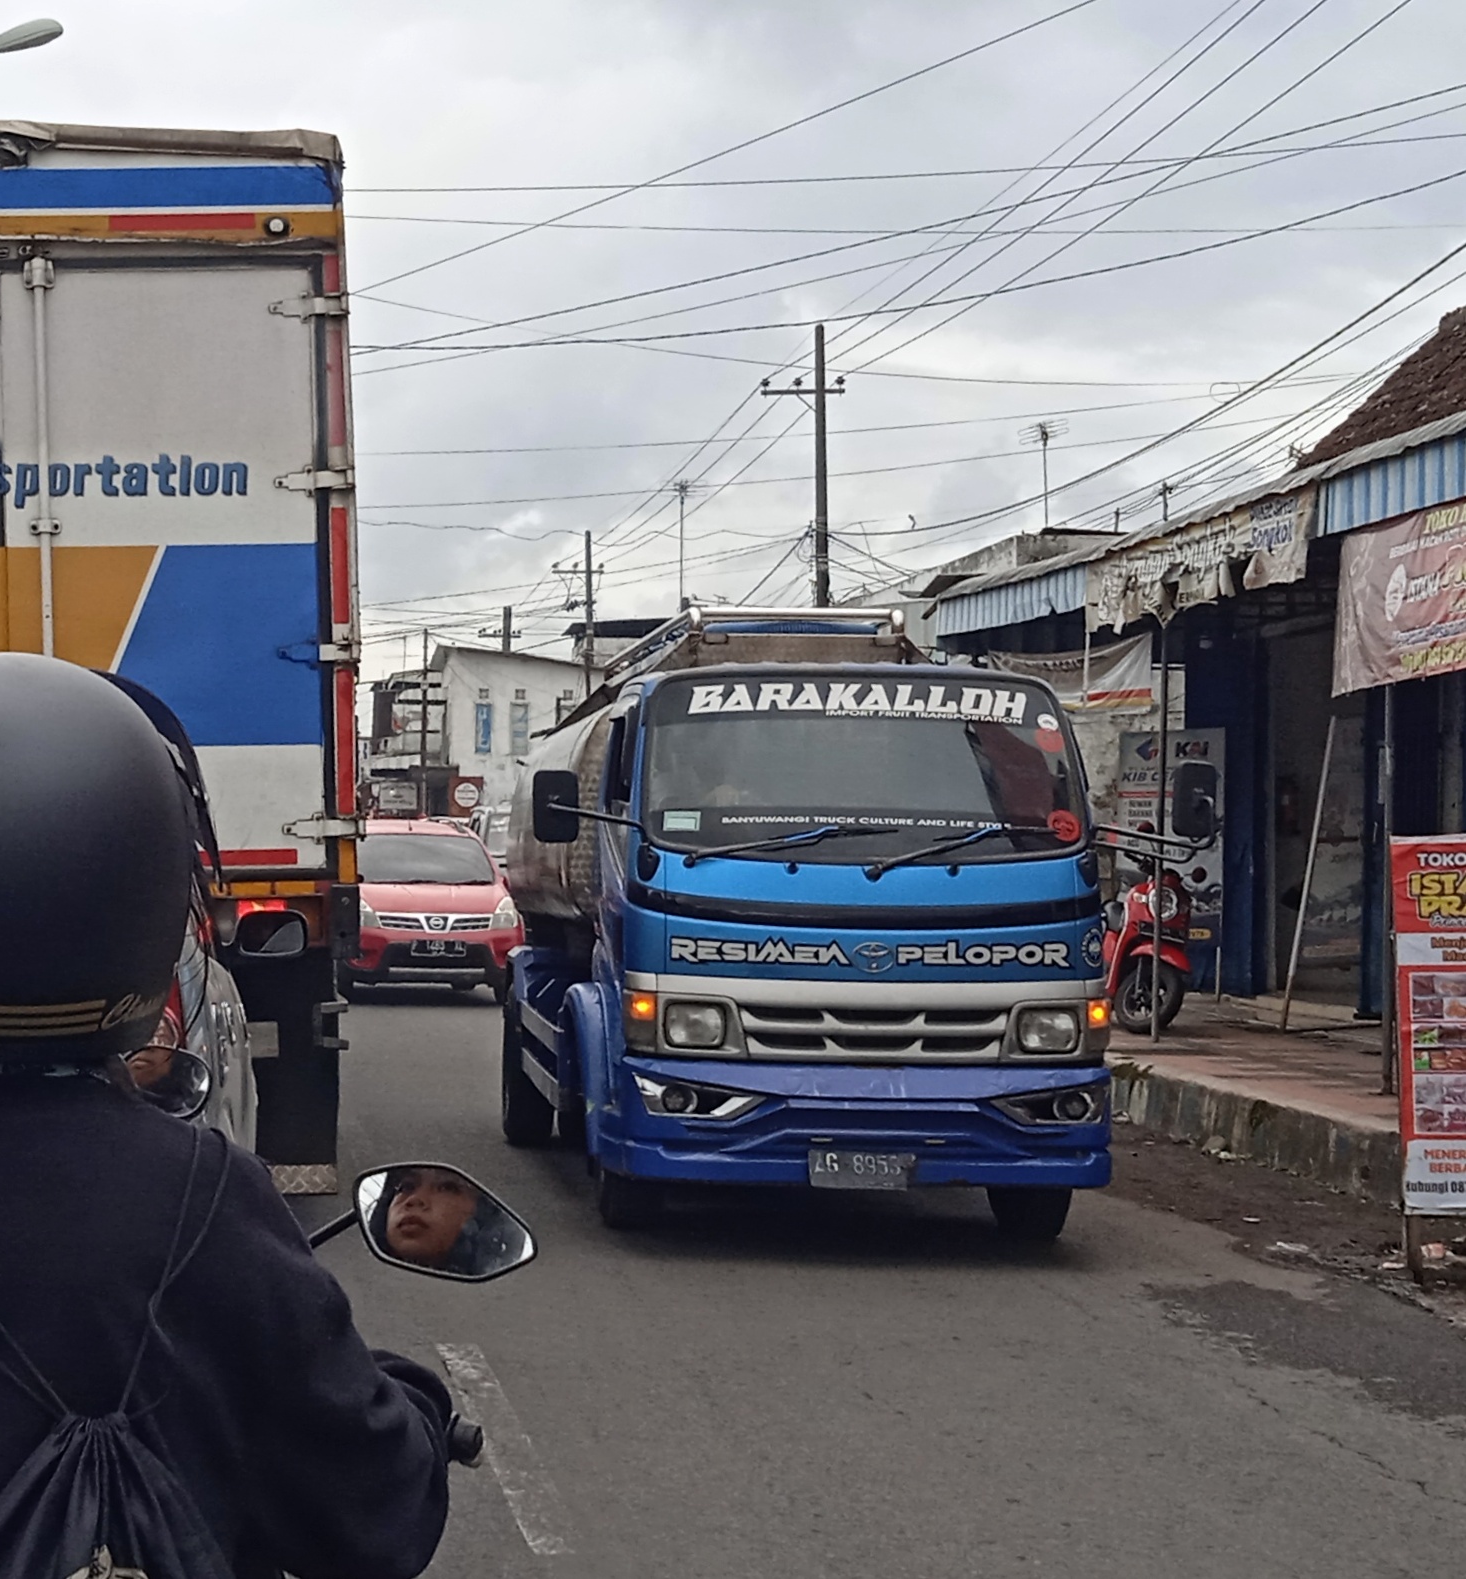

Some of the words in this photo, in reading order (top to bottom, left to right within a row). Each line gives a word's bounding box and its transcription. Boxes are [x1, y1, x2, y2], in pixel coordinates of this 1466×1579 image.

[825, 709, 874, 718] IMPORT
[877, 710, 910, 718] FRUIT
[914, 710, 1023, 725] TRANSPORTATION
[721, 815, 809, 824] BANYUWANGI
[813, 816, 855, 824] TRUCK
[858, 816, 914, 826] CULTURE
[917, 818, 947, 827] AND
[950, 819, 975, 828] LIFE
[1417, 852, 1466, 868] TOKO
